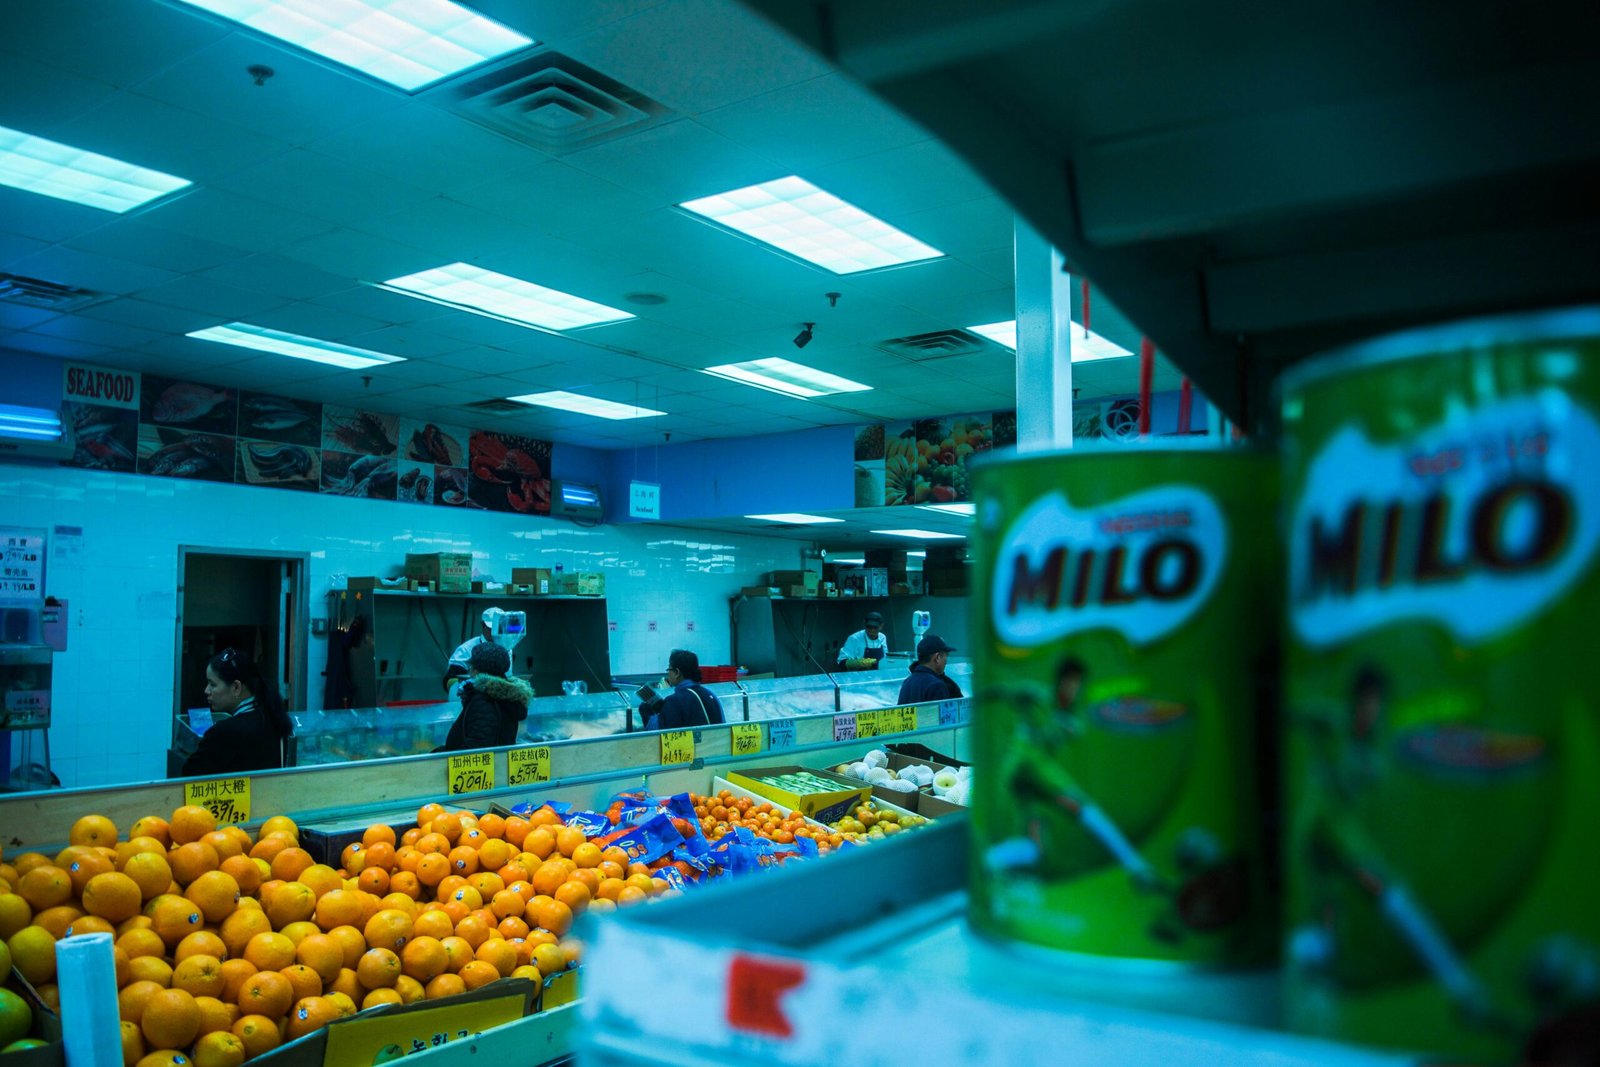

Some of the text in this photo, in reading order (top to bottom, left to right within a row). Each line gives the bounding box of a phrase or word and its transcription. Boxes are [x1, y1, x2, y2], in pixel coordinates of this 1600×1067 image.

[67, 366, 135, 402] SEAFOOD
[1303, 481, 1574, 602] MILO
[1007, 539, 1203, 615] MILO
[453, 754, 491, 768] 加州中橙
[191, 780, 245, 798] 加州大橙
